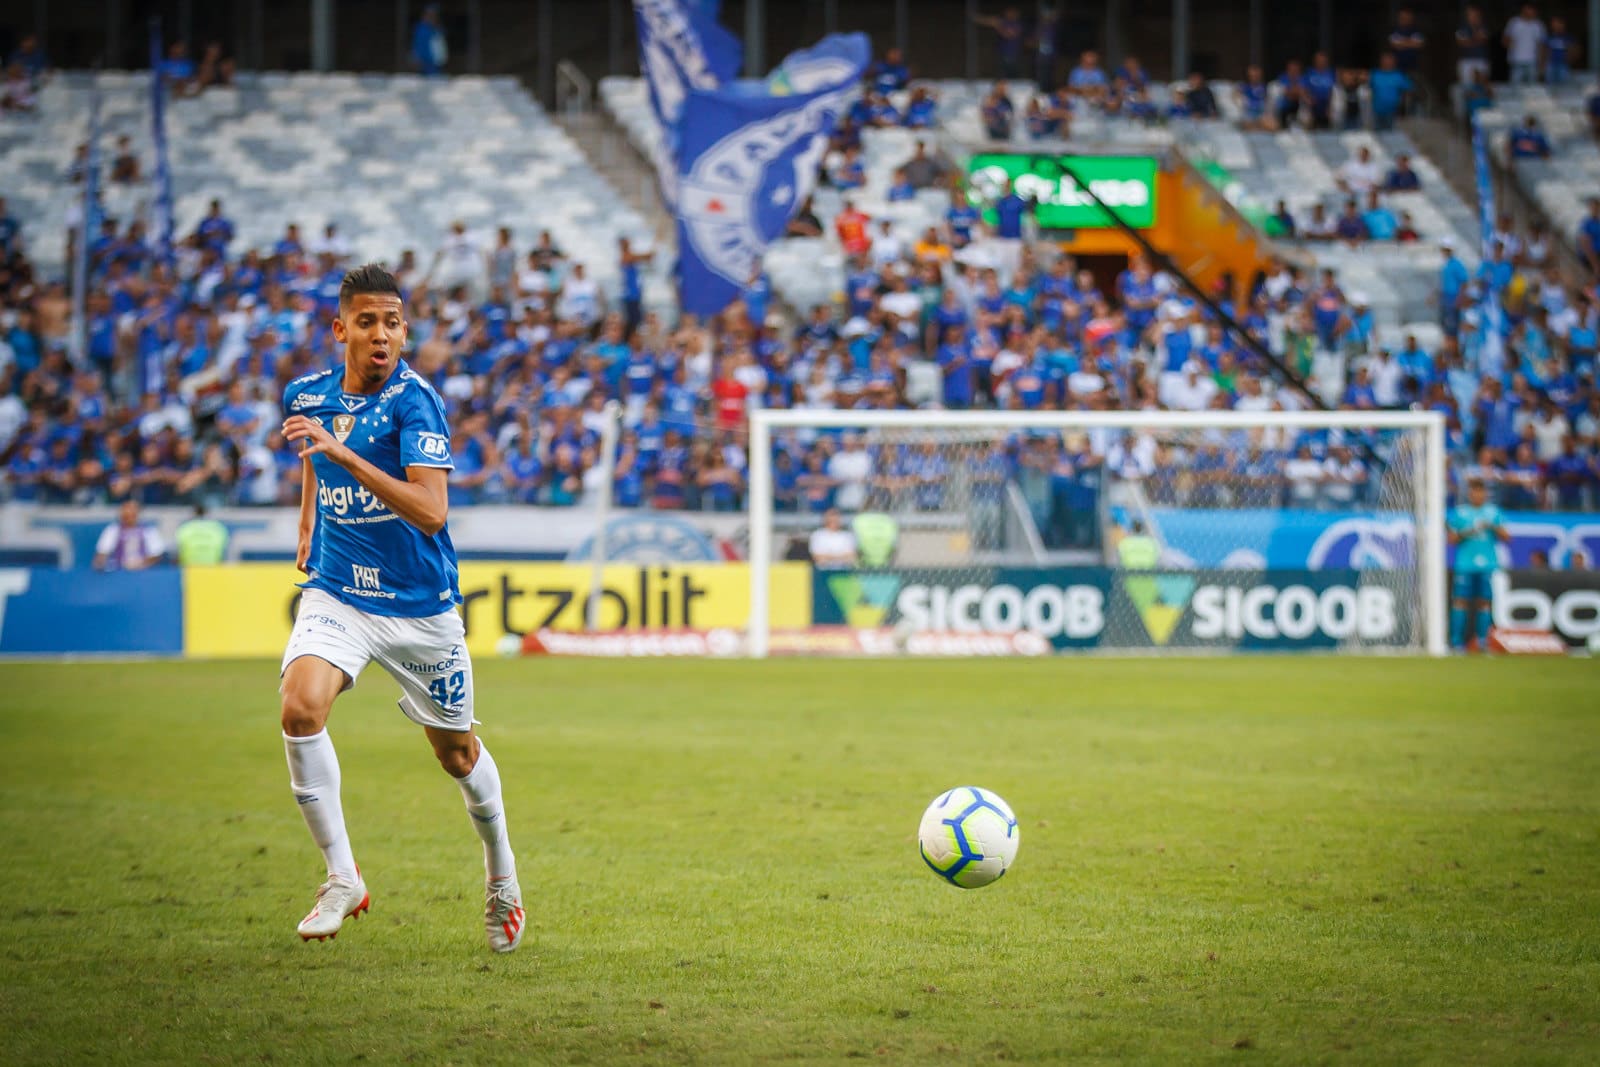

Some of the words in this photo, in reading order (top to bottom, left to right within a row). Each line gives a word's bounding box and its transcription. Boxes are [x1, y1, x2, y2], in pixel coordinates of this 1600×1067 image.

[898, 583, 1106, 640] SICOOB
[1190, 583, 1396, 641] SICOOB
[428, 670, 465, 707] 42
